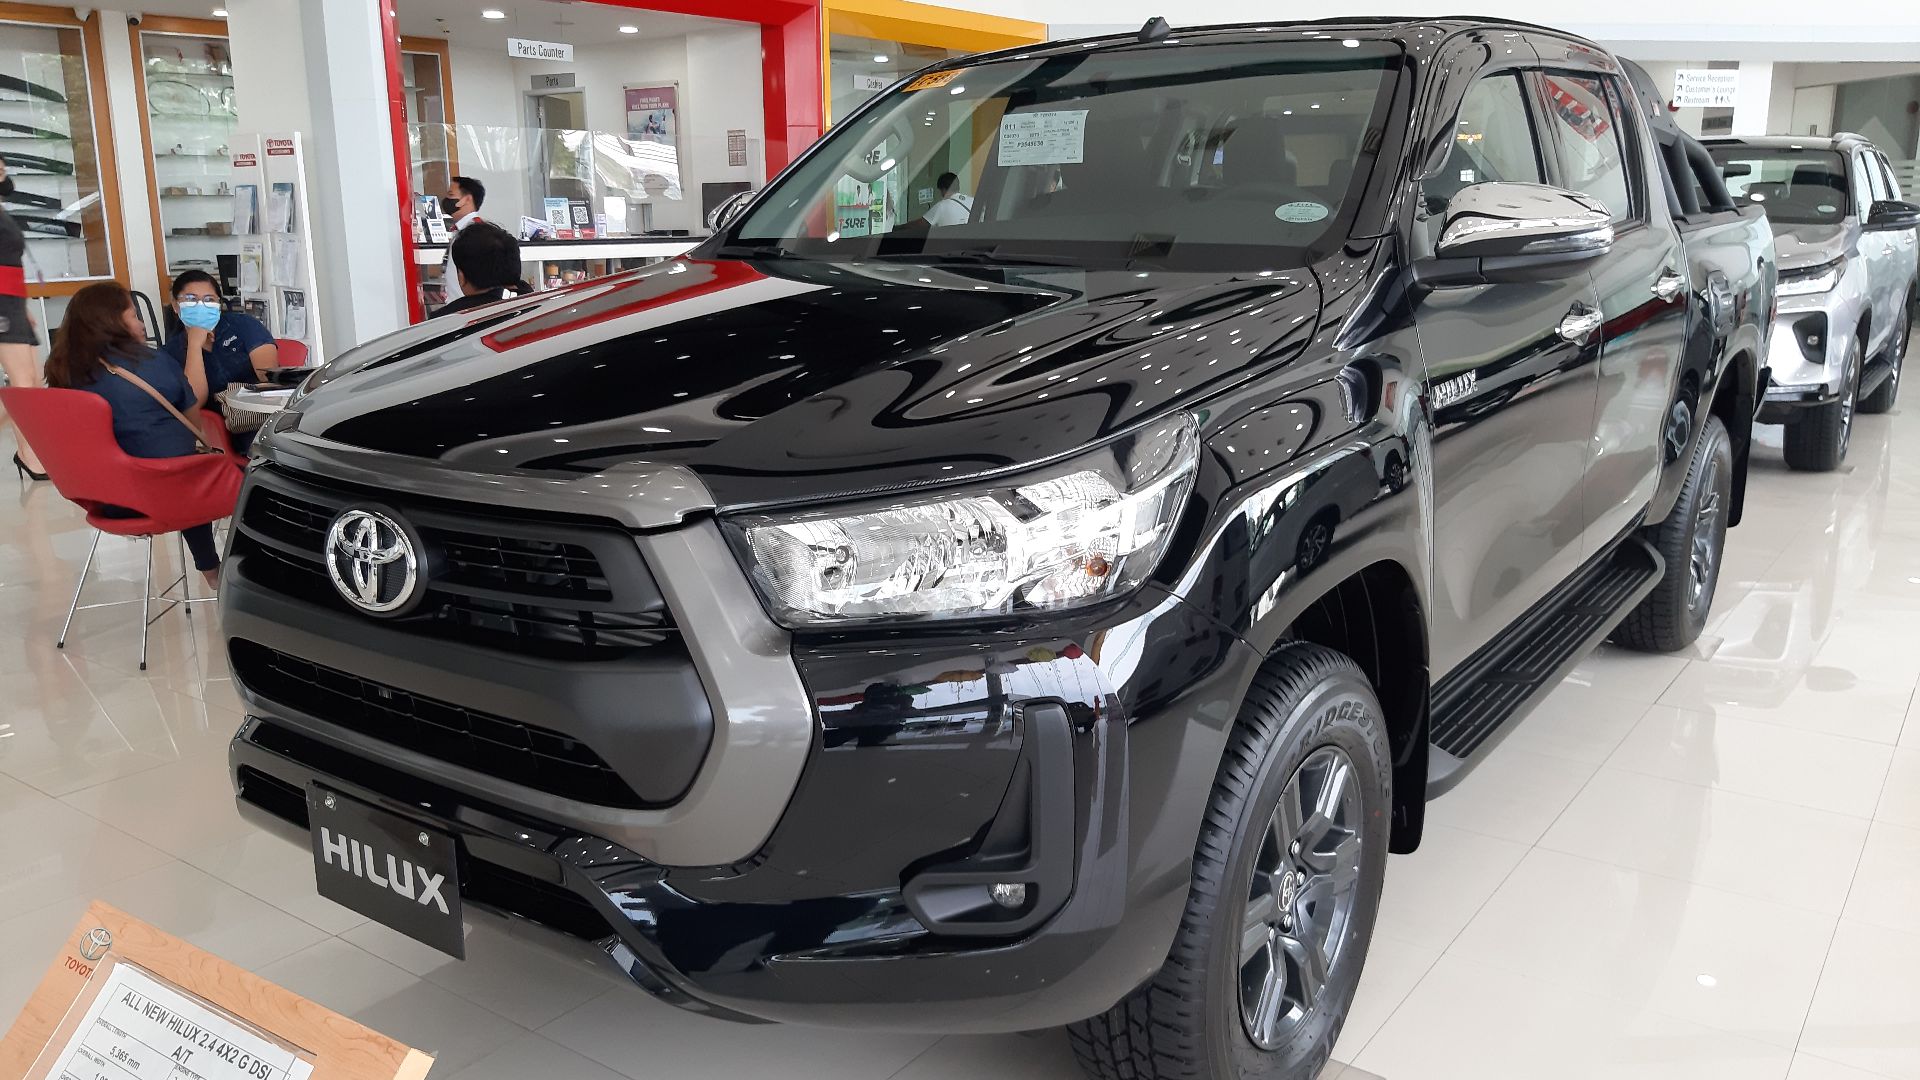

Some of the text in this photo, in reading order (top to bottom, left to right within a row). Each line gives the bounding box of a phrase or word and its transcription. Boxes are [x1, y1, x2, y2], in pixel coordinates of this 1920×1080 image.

[517, 42, 565, 59] Parts Counter
[545, 77, 559, 87] Parts
[1686, 74, 1735, 83] Service Reception
[320, 826, 450, 915] HILUX
[120, 991, 142, 1012] ALL
[141, 1001, 170, 1025] NEW
[165, 1014, 202, 1044] HILUX
[197, 1032, 218, 1052] 2.4
[215, 1042, 240, 1064] 4X2
[237, 1054, 250, 1070] G
[109, 1045, 141, 1071] 5,365 mm
[170, 1045, 194, 1065] A/T
